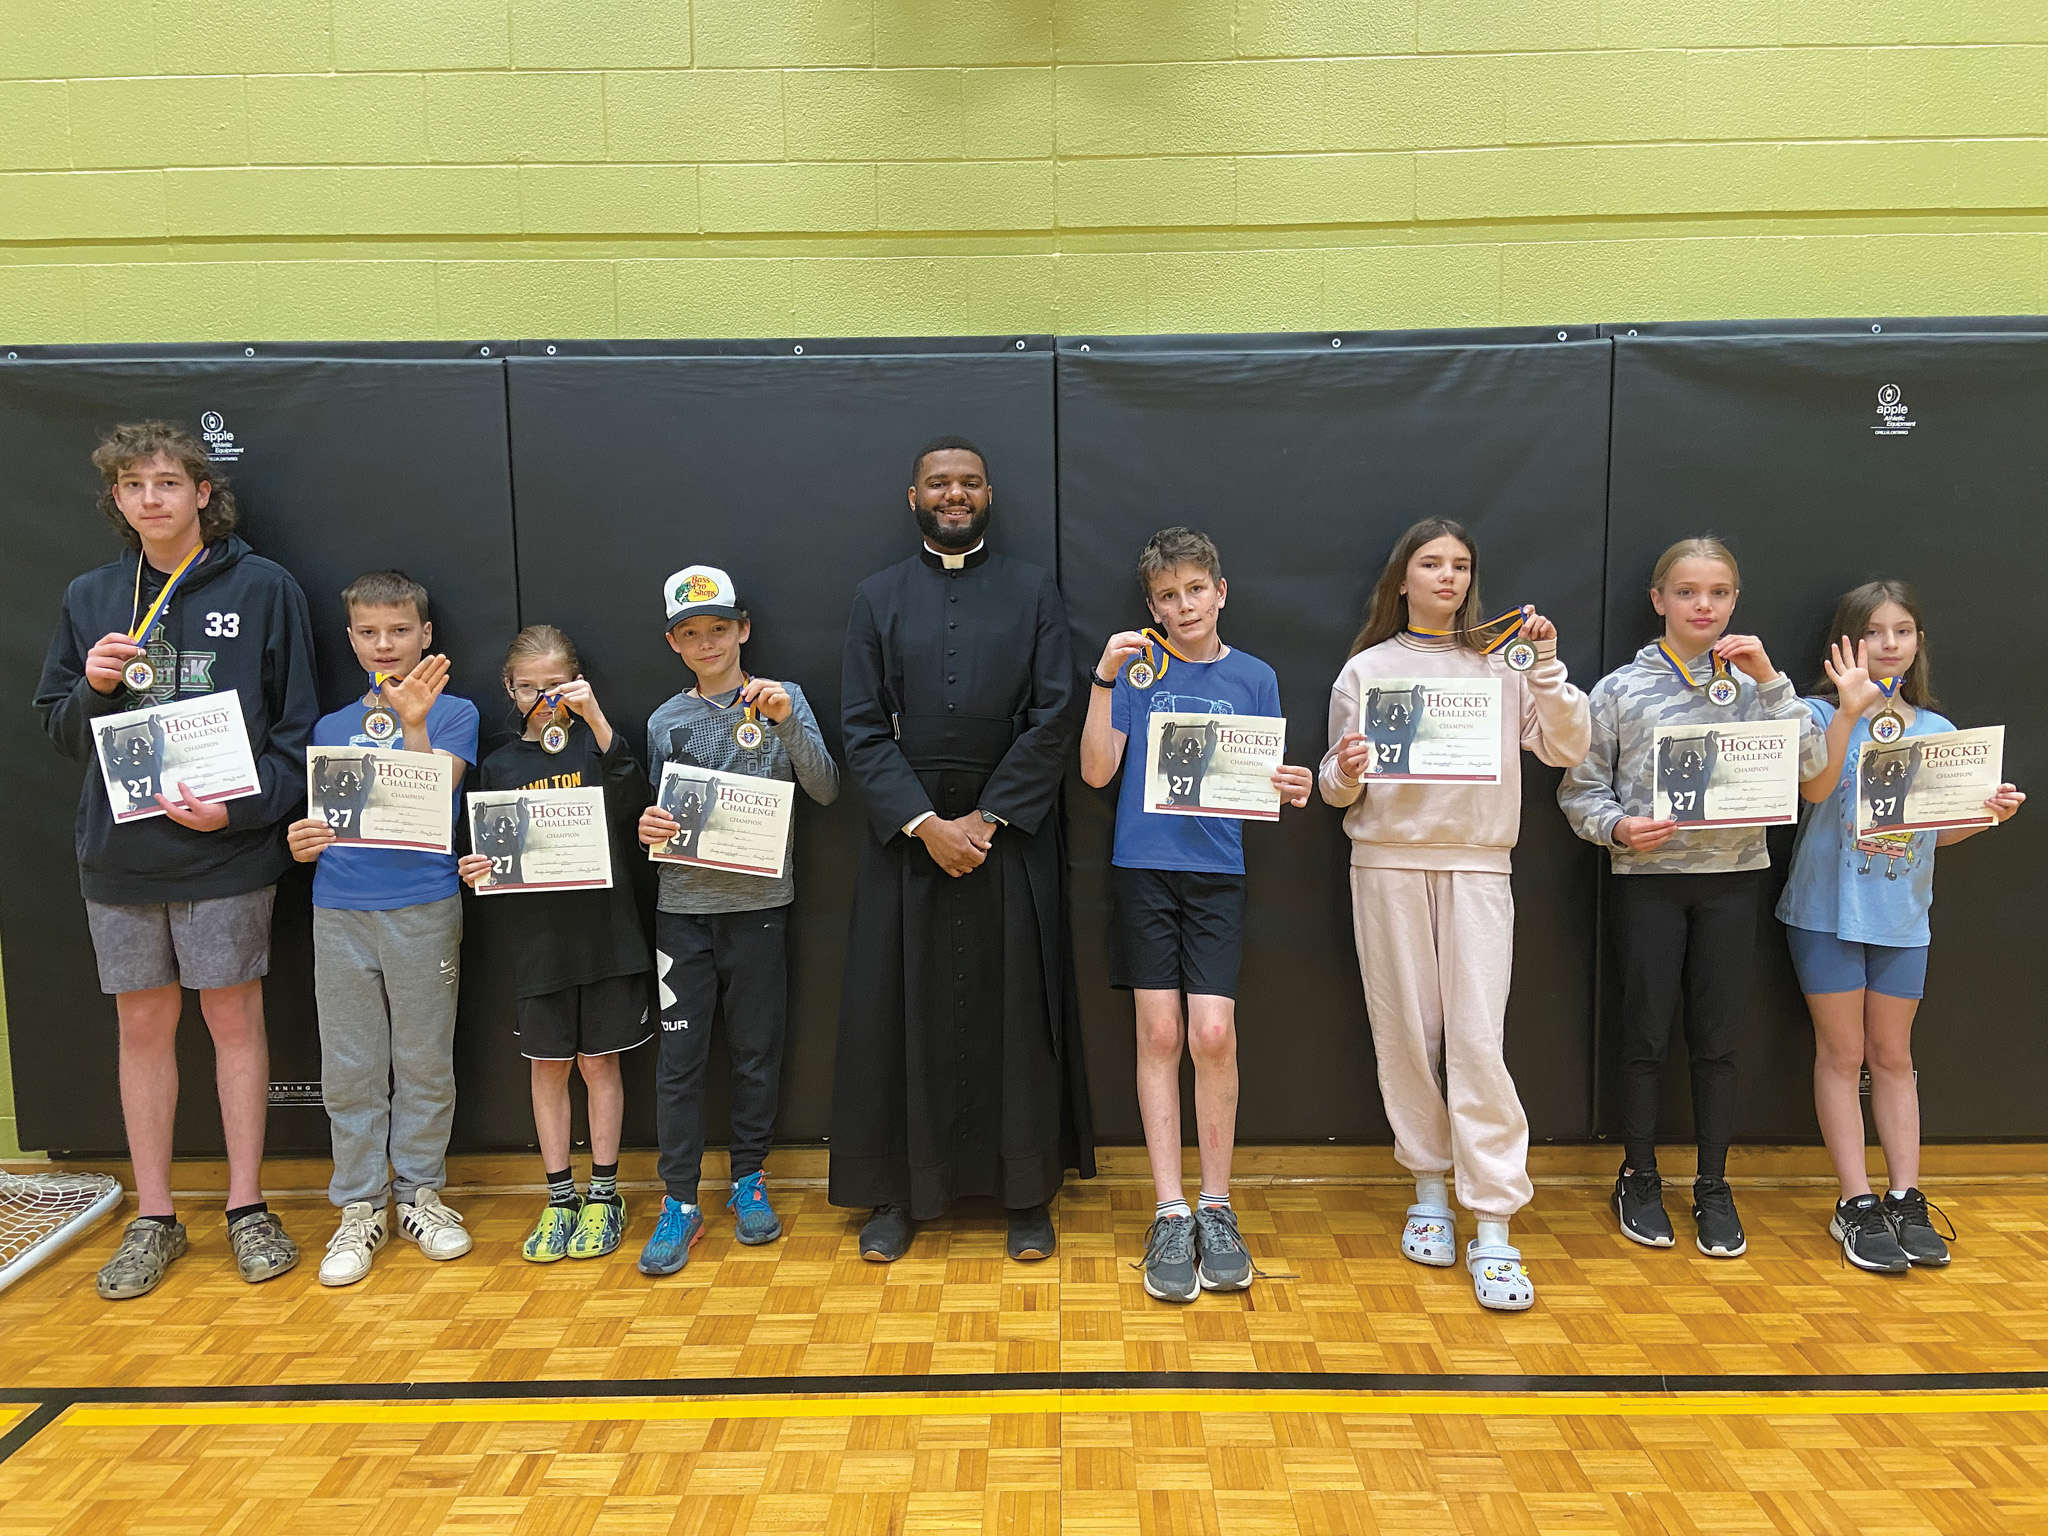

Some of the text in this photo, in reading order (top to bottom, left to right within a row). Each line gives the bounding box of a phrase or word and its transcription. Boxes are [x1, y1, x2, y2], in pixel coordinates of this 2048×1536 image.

[1876, 404, 1908, 416] apple
[203, 430, 234, 442] apple
[691, 576, 711, 584] Bass
[693, 589, 717, 598] Shops
[204, 612, 240, 638] 33
[1427, 694, 1492, 708] HOCKEY
[1429, 708, 1488, 718] CHALLENGE
[165, 711, 230, 734] HOCKEY
[171, 725, 230, 743] CHALLENGE
[1219, 730, 1282, 747] HOCKEY
[1222, 743, 1277, 756] CHALLENGE
[1720, 738, 1788, 752] HOCKEY
[1380, 743, 1402, 763] 27
[1723, 752, 1783, 762] CHALLENGE
[1924, 745, 1992, 760] HOCKEY
[1230, 759, 1264, 767] CHAMPION
[1926, 757, 1987, 769] CHALLENGE
[378, 763, 442, 782] HOCKEY
[1936, 771, 1972, 779] CHAMPION
[127, 776, 152, 798] 27
[381, 777, 438, 791] CHALLENGE
[1171, 775, 1194, 795] 27
[391, 792, 425, 801] CHAMPION
[720, 787, 781, 808] HOCKEY
[1673, 790, 1697, 811] 27
[531, 805, 594, 818] HOCKEY
[721, 802, 776, 817] CHALLENGE
[1874, 797, 1897, 817] 27
[328, 808, 353, 828] 27
[535, 819, 592, 828] CHALLENGE
[729, 817, 762, 826] CHAMPION
[669, 829, 692, 847] 27
[491, 855, 513, 874] 27
[661, 1019, 688, 1032] OUR
